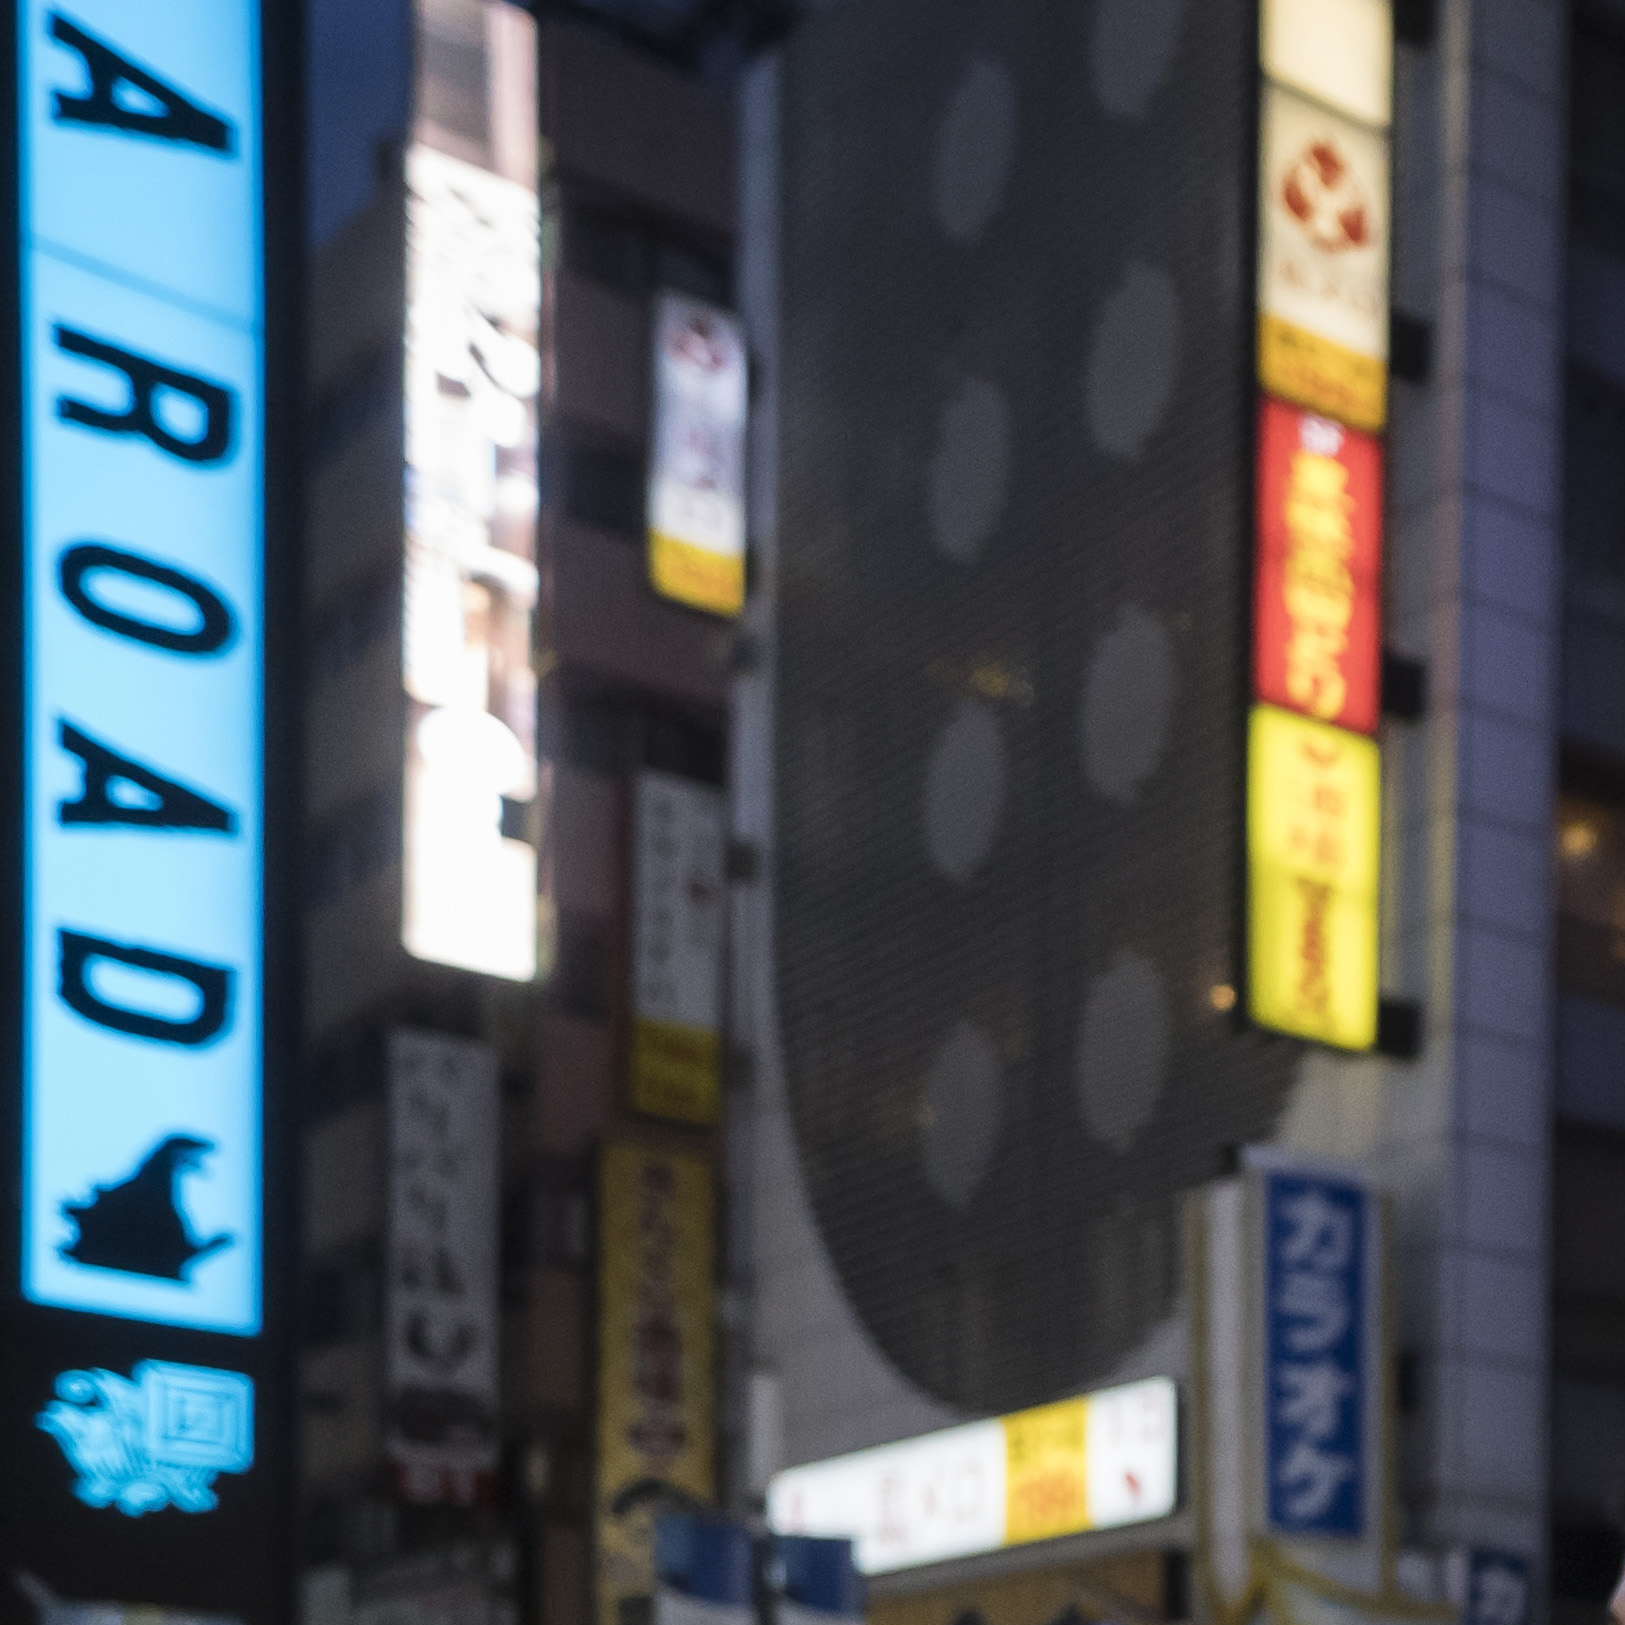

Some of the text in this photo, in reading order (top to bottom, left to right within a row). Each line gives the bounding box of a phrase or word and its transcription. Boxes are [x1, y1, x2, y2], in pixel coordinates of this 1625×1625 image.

[52, 322, 237, 1048] ROAD
[1277, 1194, 1356, 1518] カラオケ
